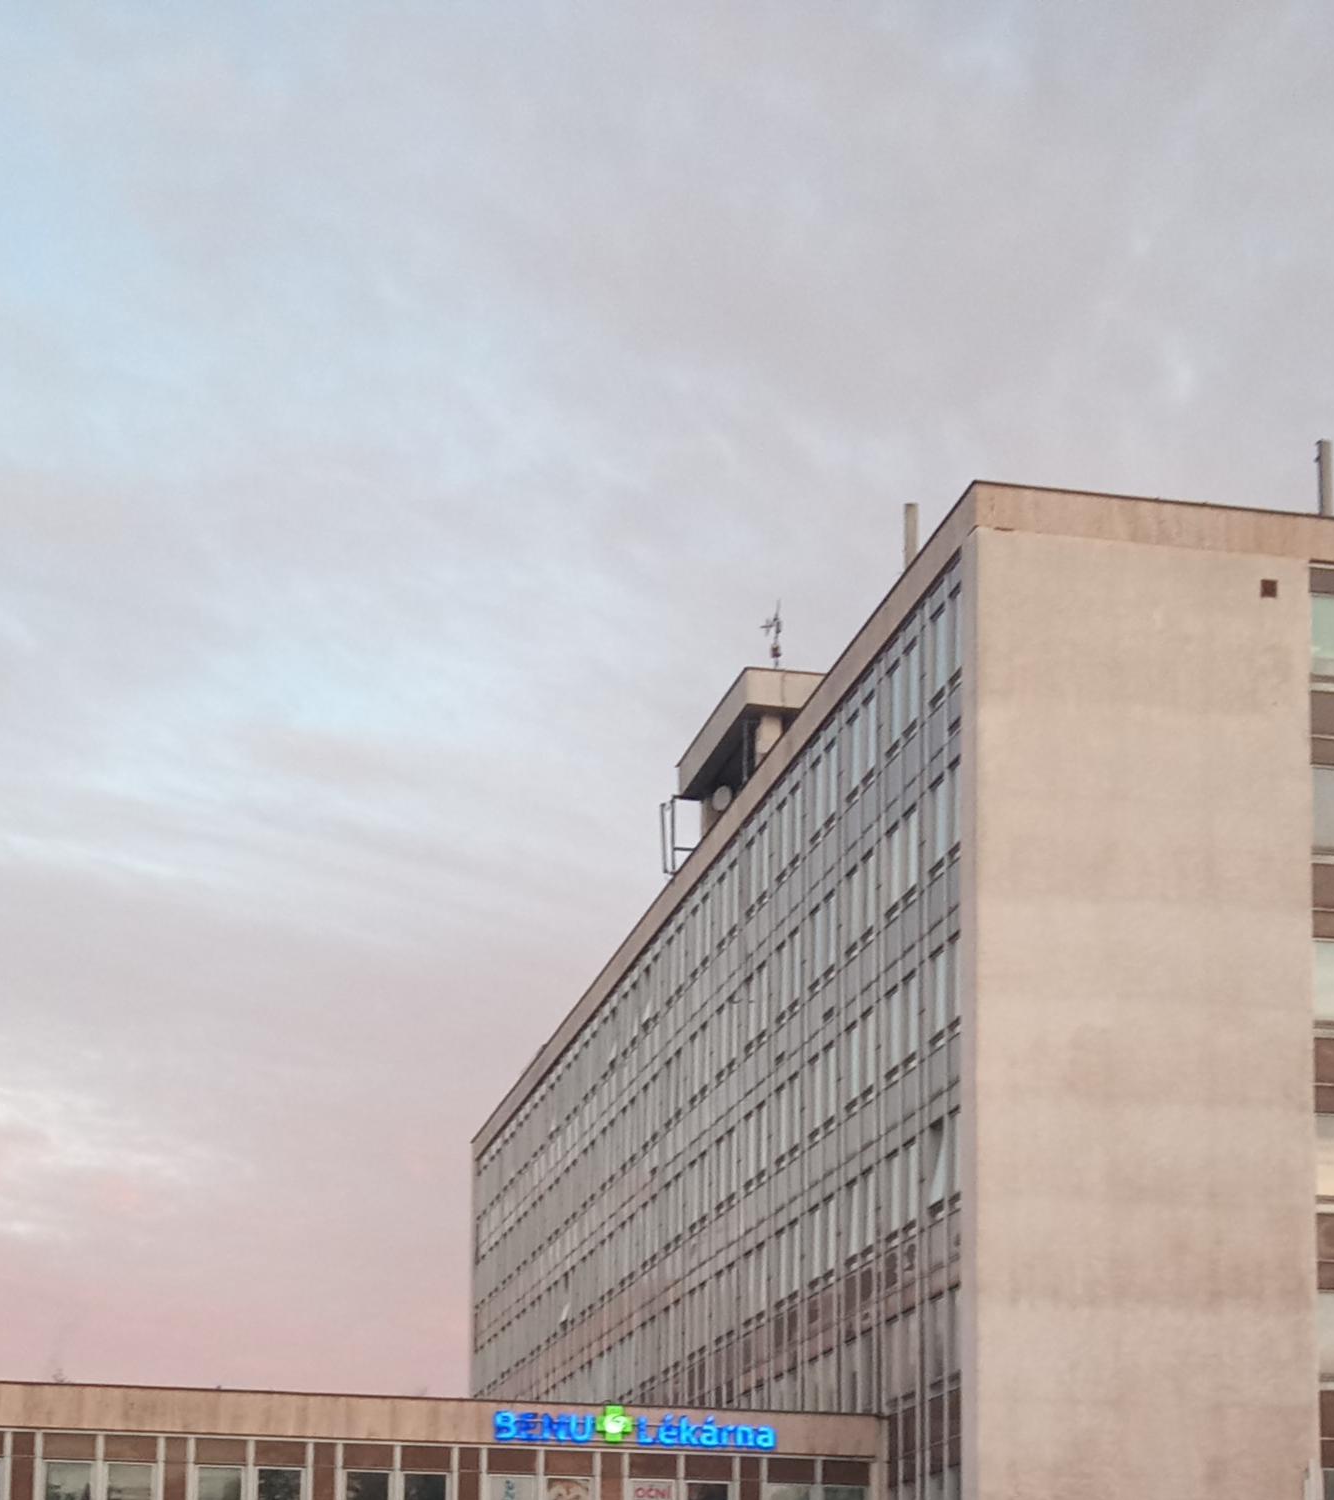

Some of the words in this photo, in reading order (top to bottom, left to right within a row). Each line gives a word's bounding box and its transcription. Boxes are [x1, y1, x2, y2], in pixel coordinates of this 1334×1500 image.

[493, 1410, 596, 1443] BENU
[636, 1413, 777, 1449] Lékárna
[634, 1484, 671, 1499] OČNÍ
